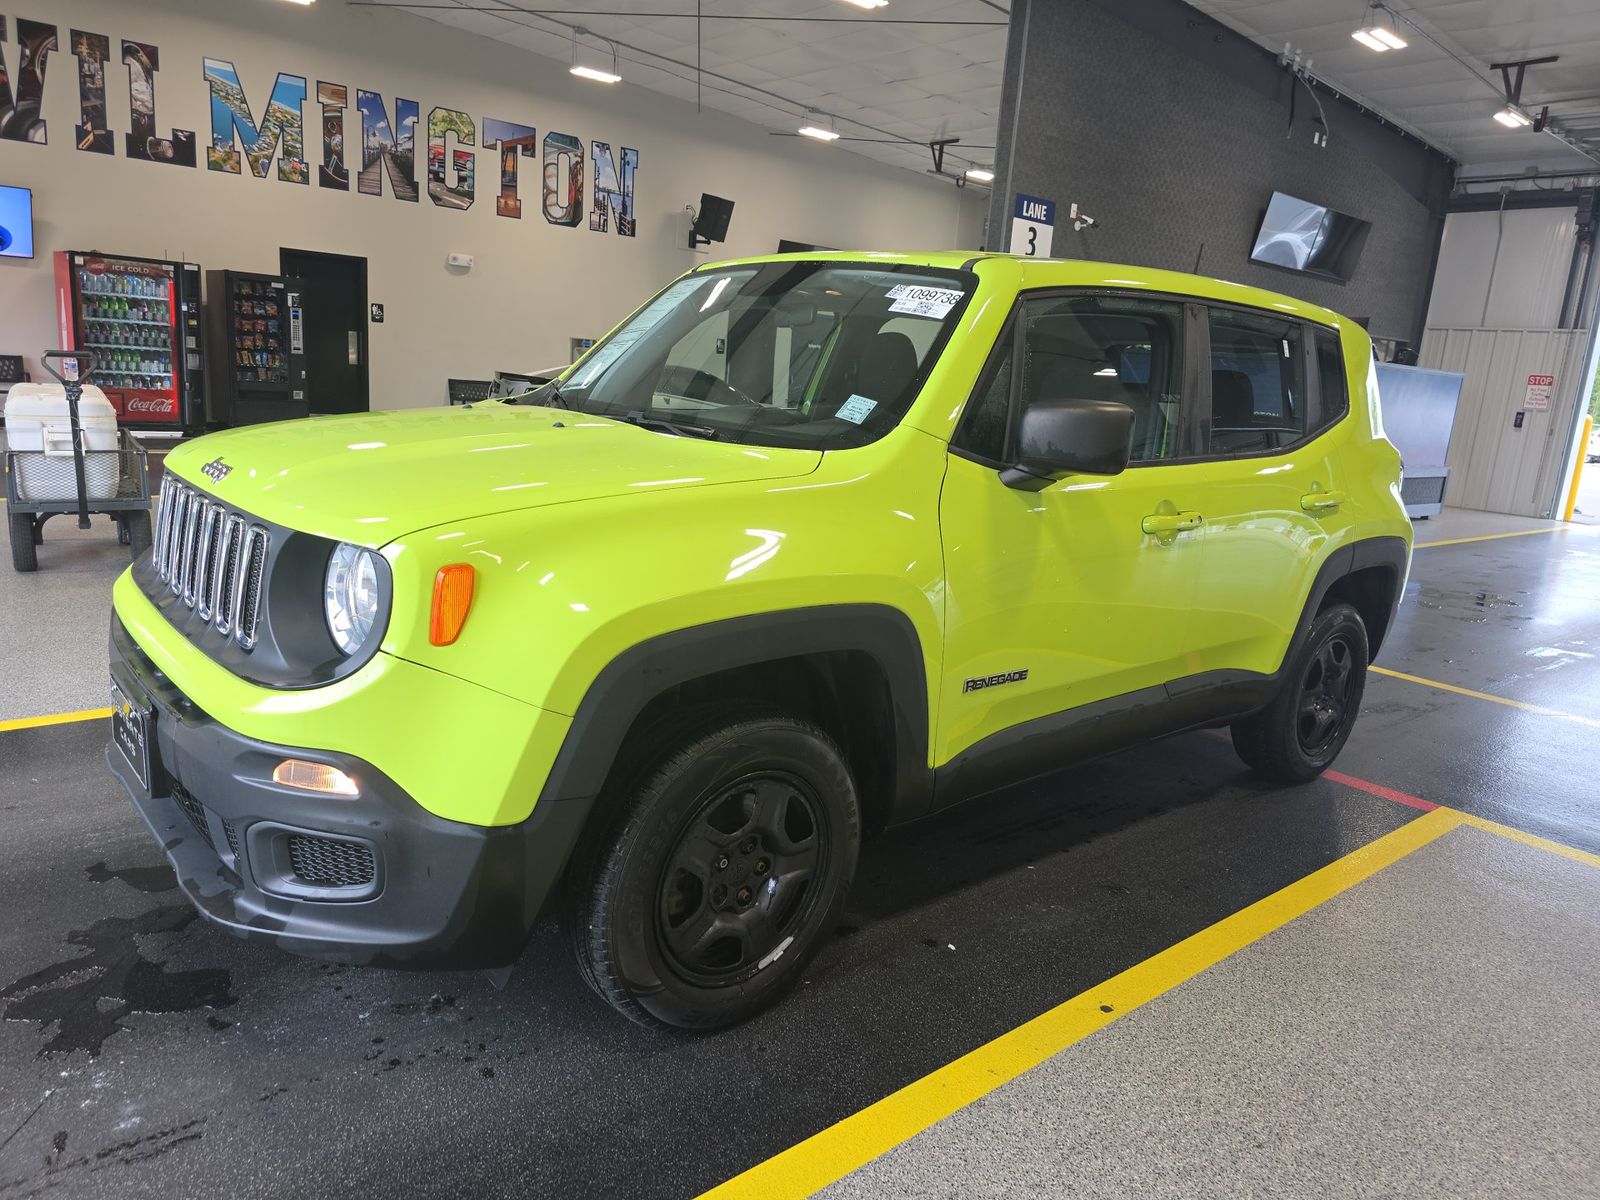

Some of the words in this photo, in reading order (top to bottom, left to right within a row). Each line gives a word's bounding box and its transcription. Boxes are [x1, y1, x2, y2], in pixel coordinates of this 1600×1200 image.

[1022, 201, 1048, 221] LANE
[1025, 226, 1038, 256] 3
[128, 265, 149, 273] COLD
[906, 288, 962, 305] 1099738
[1529, 376, 1552, 385] STOP
[128, 398, 174, 412] Coca-Cola
[963, 668, 1028, 694] RENEGADE
